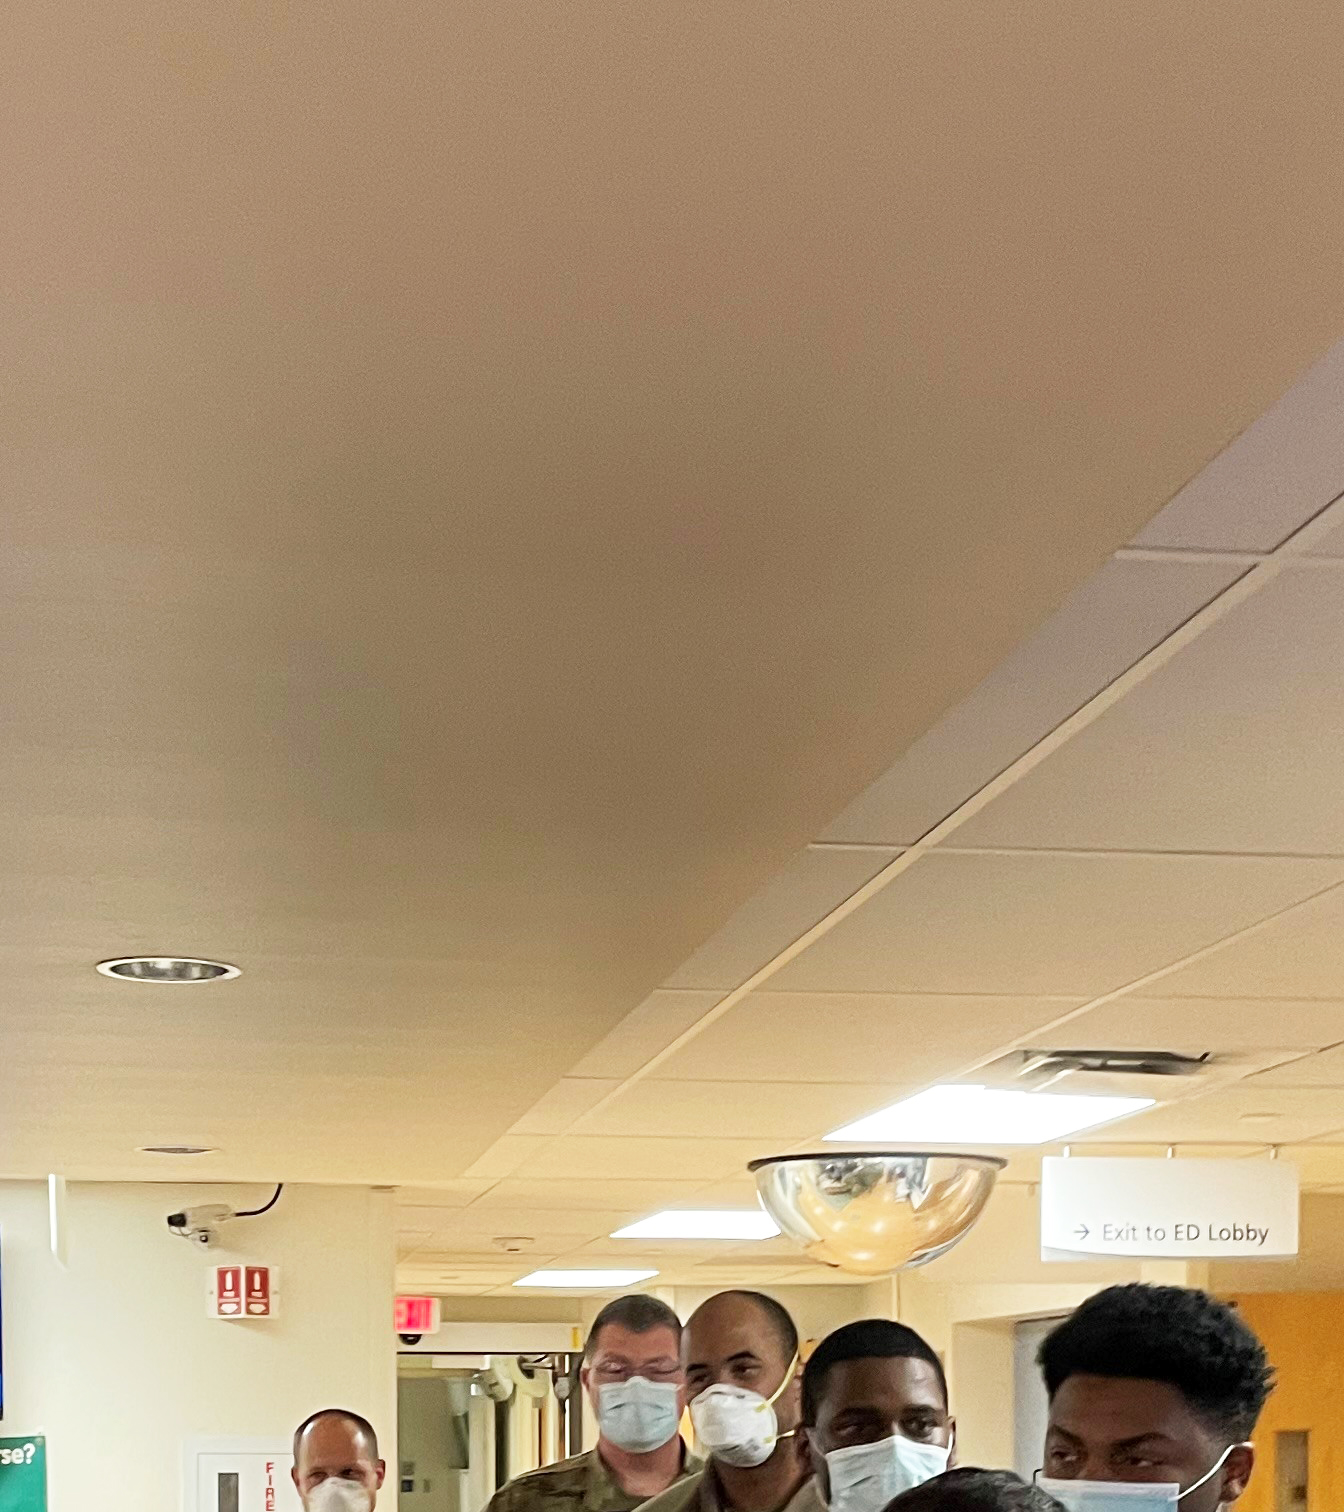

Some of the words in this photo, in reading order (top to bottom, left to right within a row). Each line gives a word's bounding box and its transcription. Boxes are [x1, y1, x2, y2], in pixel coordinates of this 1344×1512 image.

[1102, 1222, 1138, 1241] Exit
[1146, 1226, 1166, 1241] to
[1174, 1223, 1200, 1241] ED
[1208, 1222, 1269, 1246] Lobby
[265, 1462, 275, 1511] FIRE
